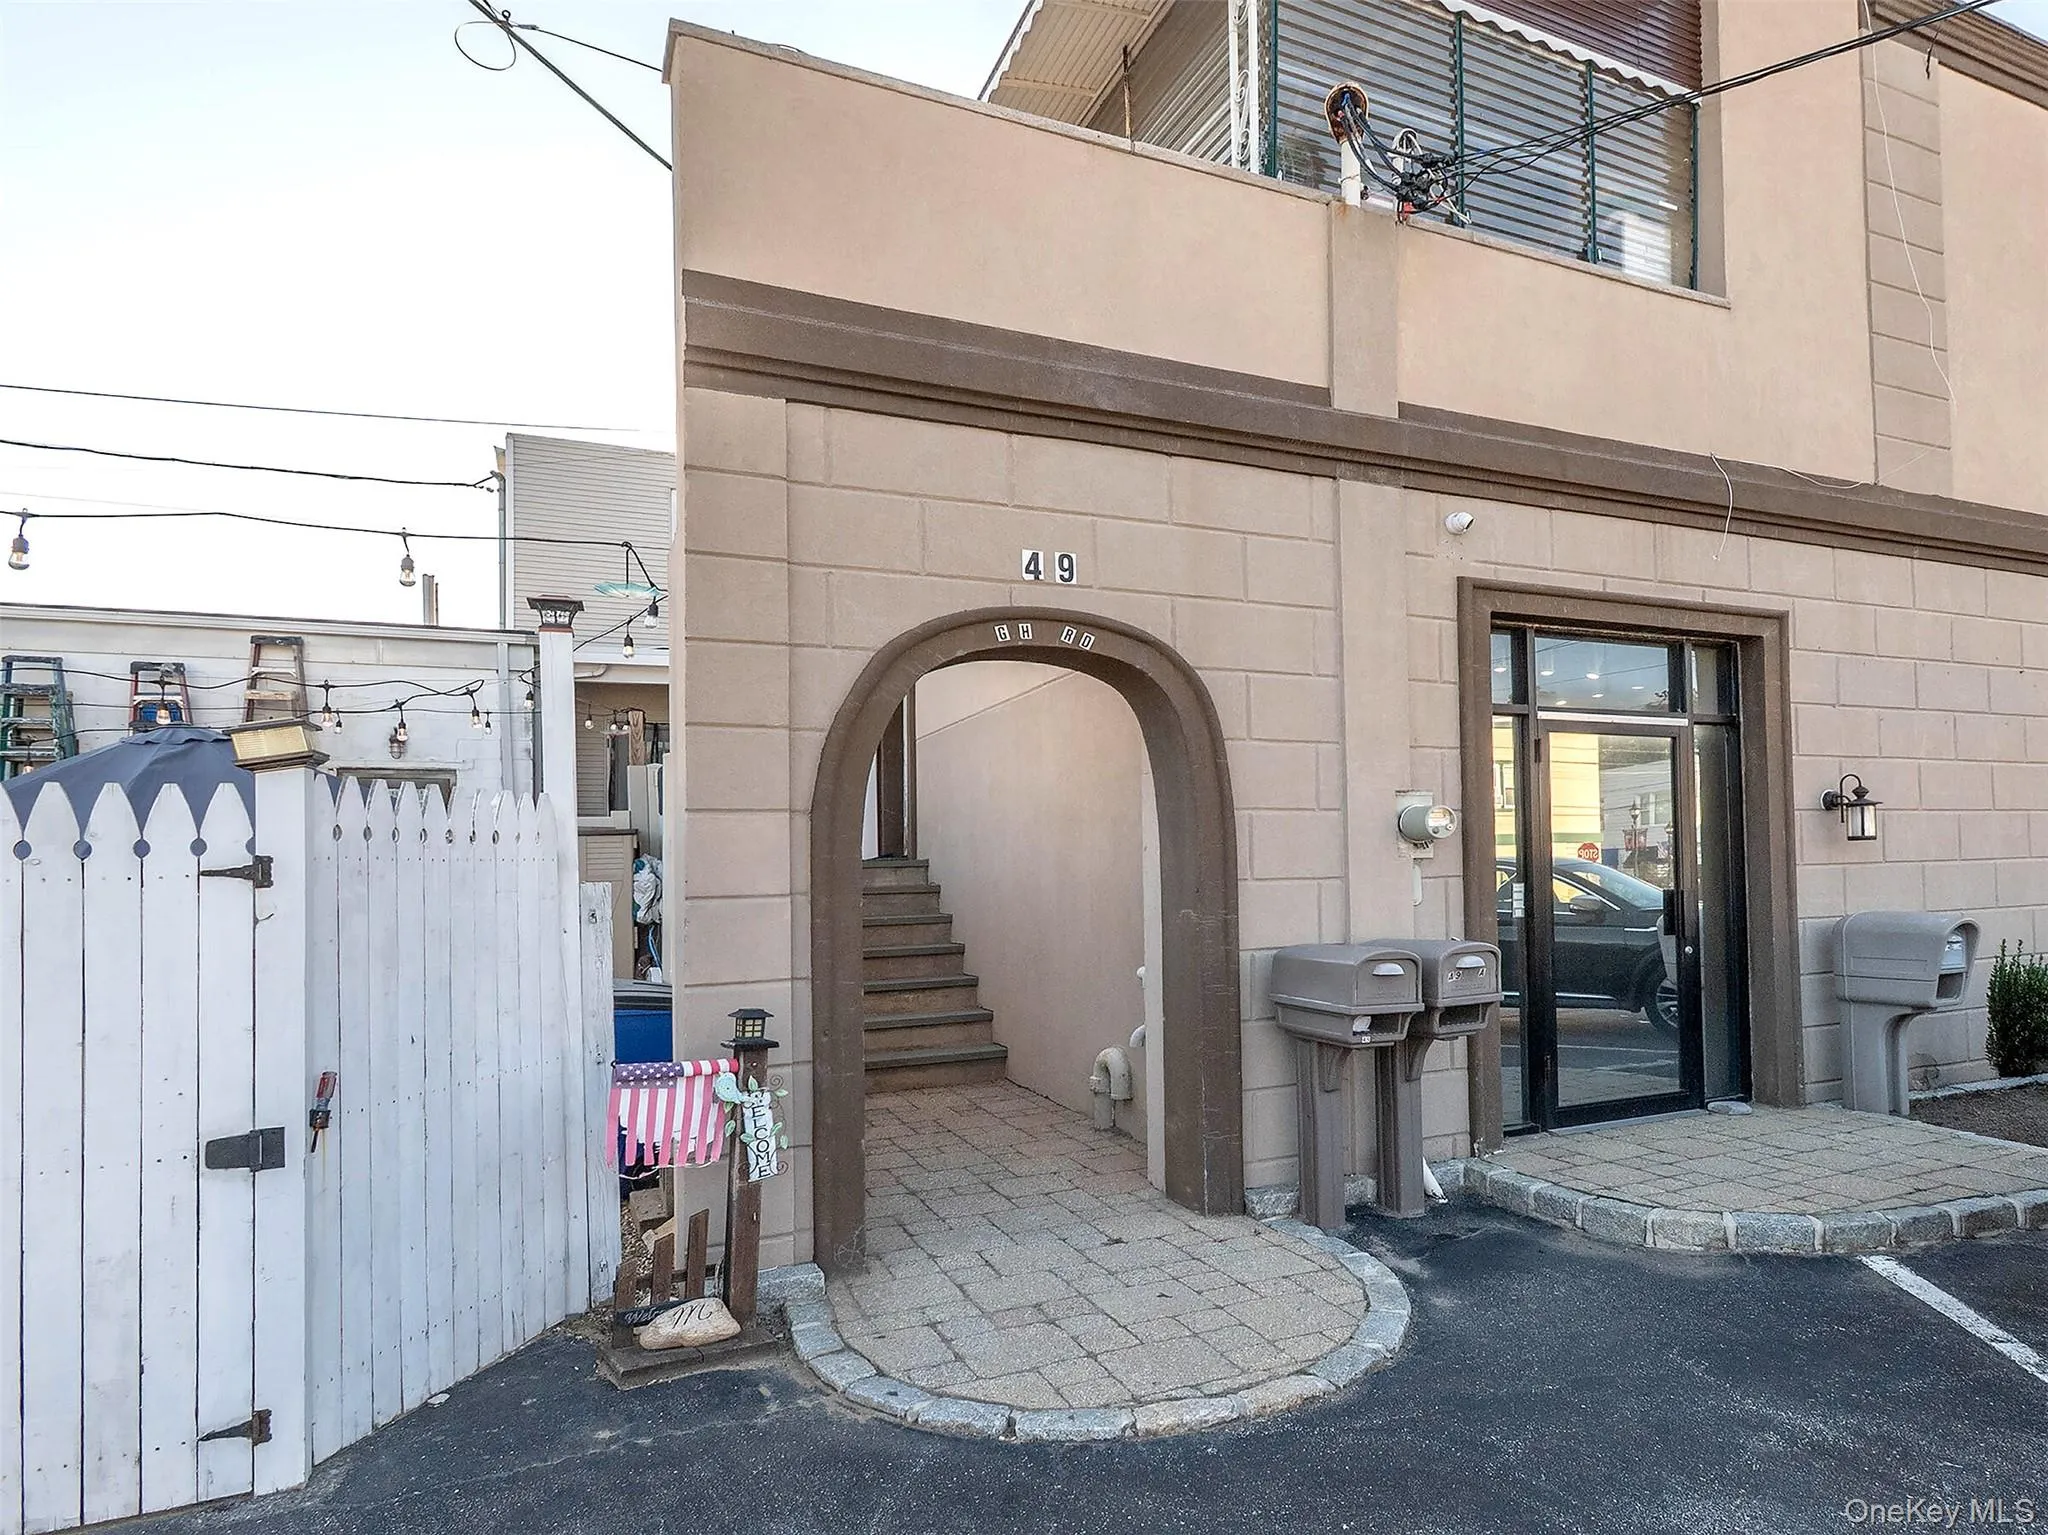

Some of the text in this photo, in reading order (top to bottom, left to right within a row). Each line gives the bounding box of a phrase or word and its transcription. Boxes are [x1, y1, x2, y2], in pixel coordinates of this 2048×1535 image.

[1024, 551, 1075, 583] 49
[996, 623, 1094, 649] GH RD
